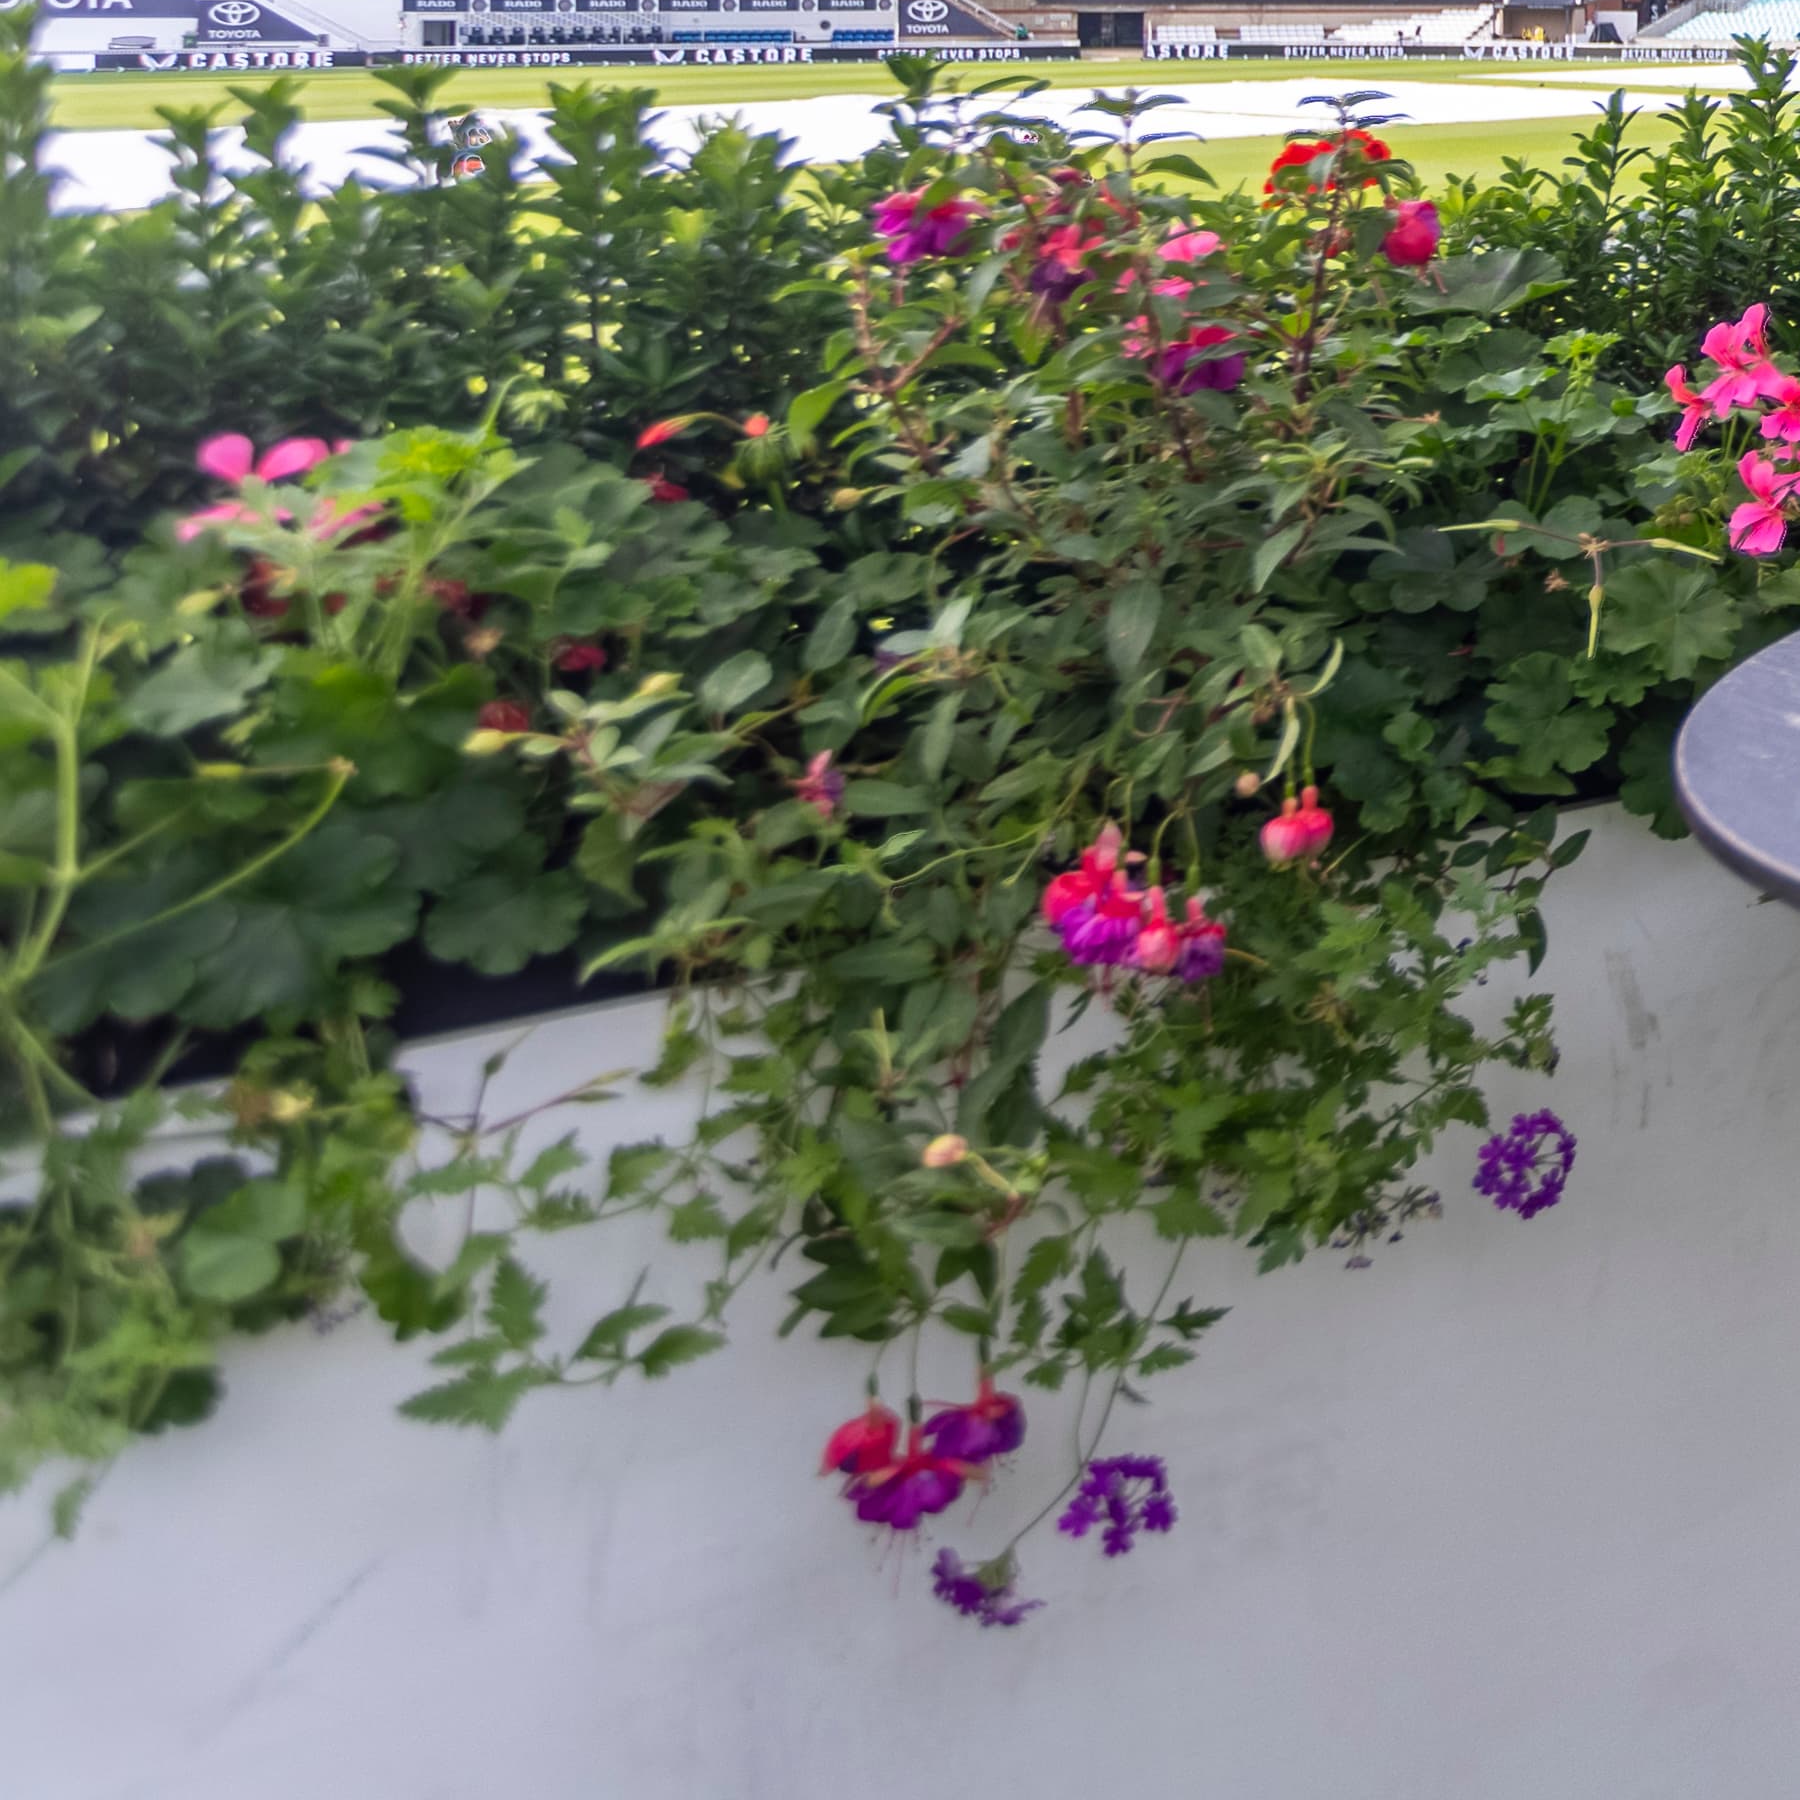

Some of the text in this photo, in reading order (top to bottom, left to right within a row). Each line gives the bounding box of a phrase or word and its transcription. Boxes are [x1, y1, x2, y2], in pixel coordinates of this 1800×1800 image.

[589, 0, 626, 8] RADO
[208, 28, 262, 39] TOYOTA
[907, 24, 949, 34] TOYOTA
[404, 52, 570, 65] BETTER NEVER STOPS
[695, 48, 813, 63] CASTORE
[979, 48, 1021, 60] STOPS
[1492, 46, 1574, 60] CASTORE
[190, 51, 334, 68] CASTORE
